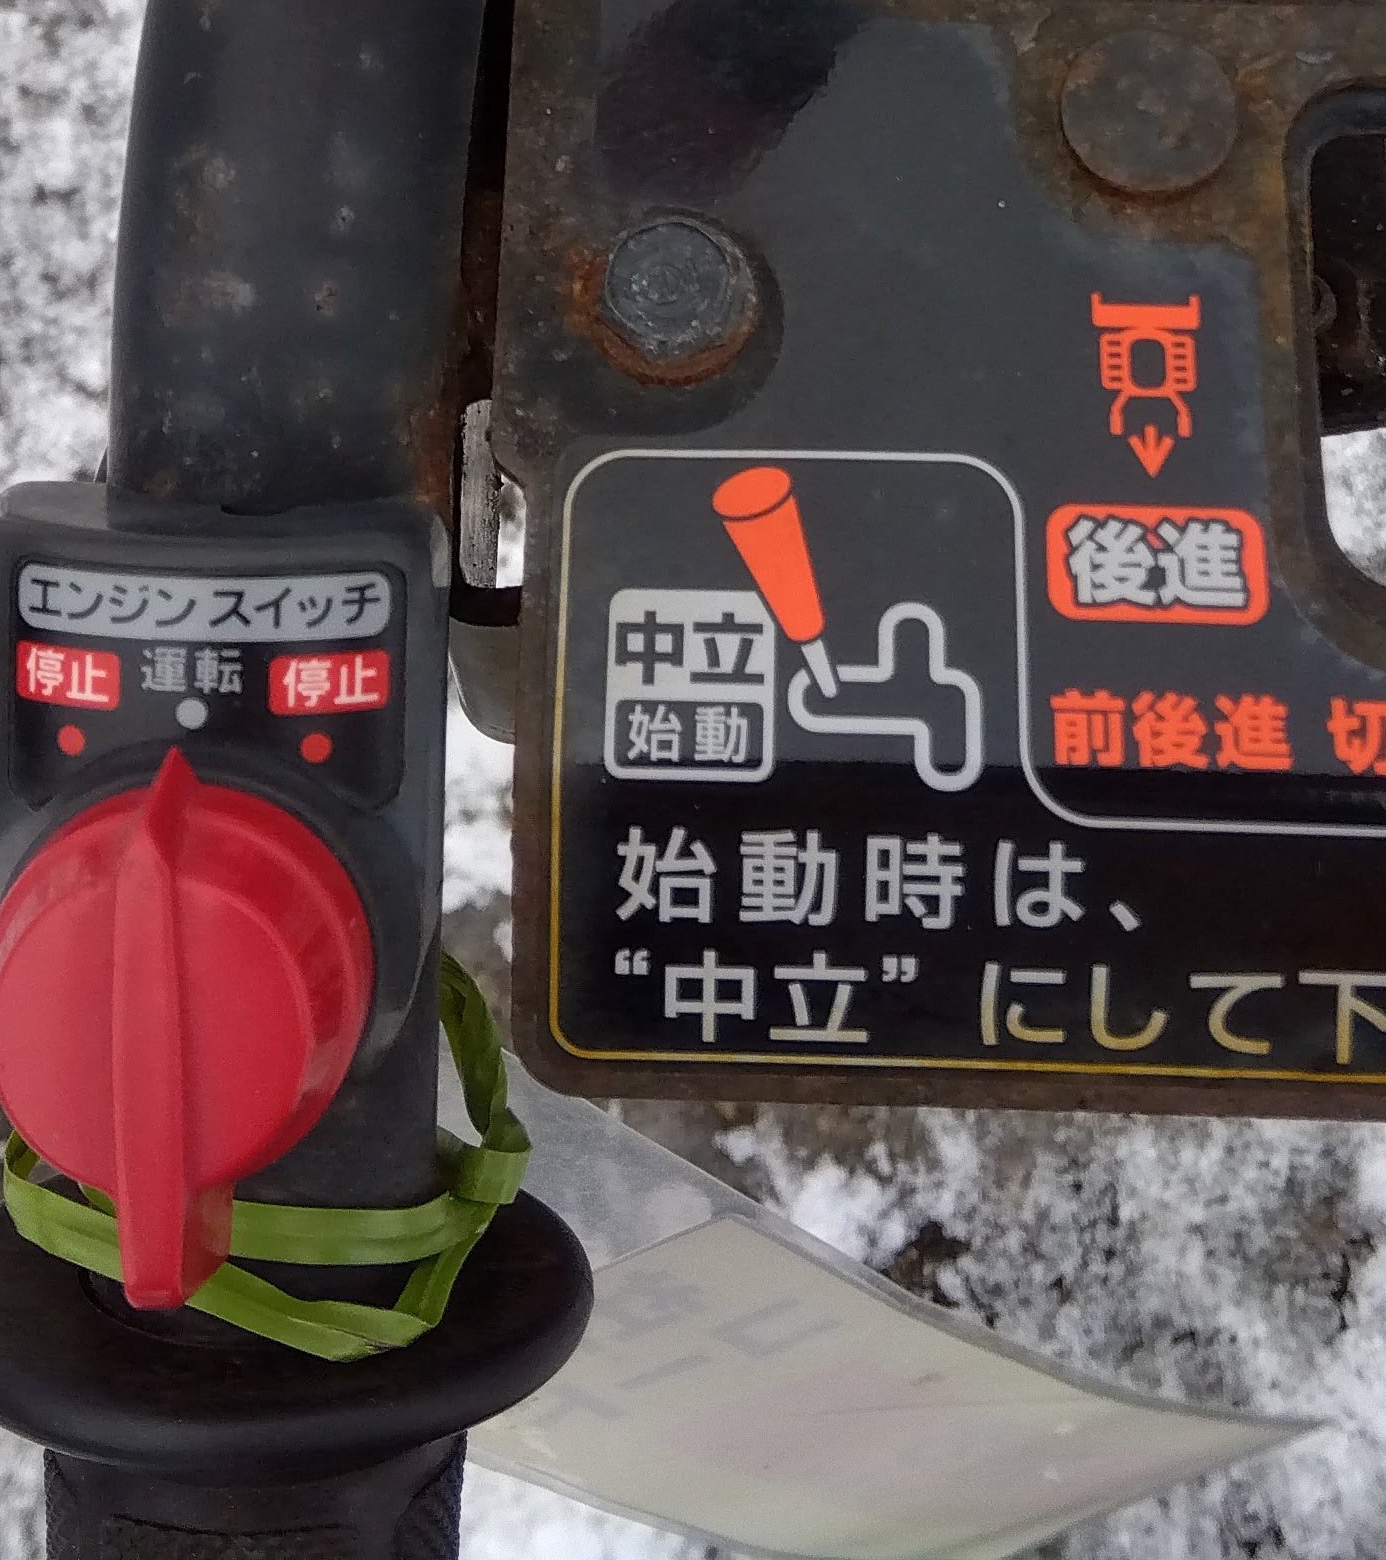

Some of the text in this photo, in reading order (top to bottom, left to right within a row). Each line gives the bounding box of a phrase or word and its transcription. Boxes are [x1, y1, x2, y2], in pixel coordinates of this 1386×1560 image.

[1067, 515, 1248, 609] 後進
[26, 646, 109, 704] 停止
[139, 644, 245, 695] 運転
[615, 610, 765, 687] 中立
[282, 654, 380, 709] 停止
[627, 703, 749, 764] 始動
[614, 825, 1142, 933] 始動時は、
